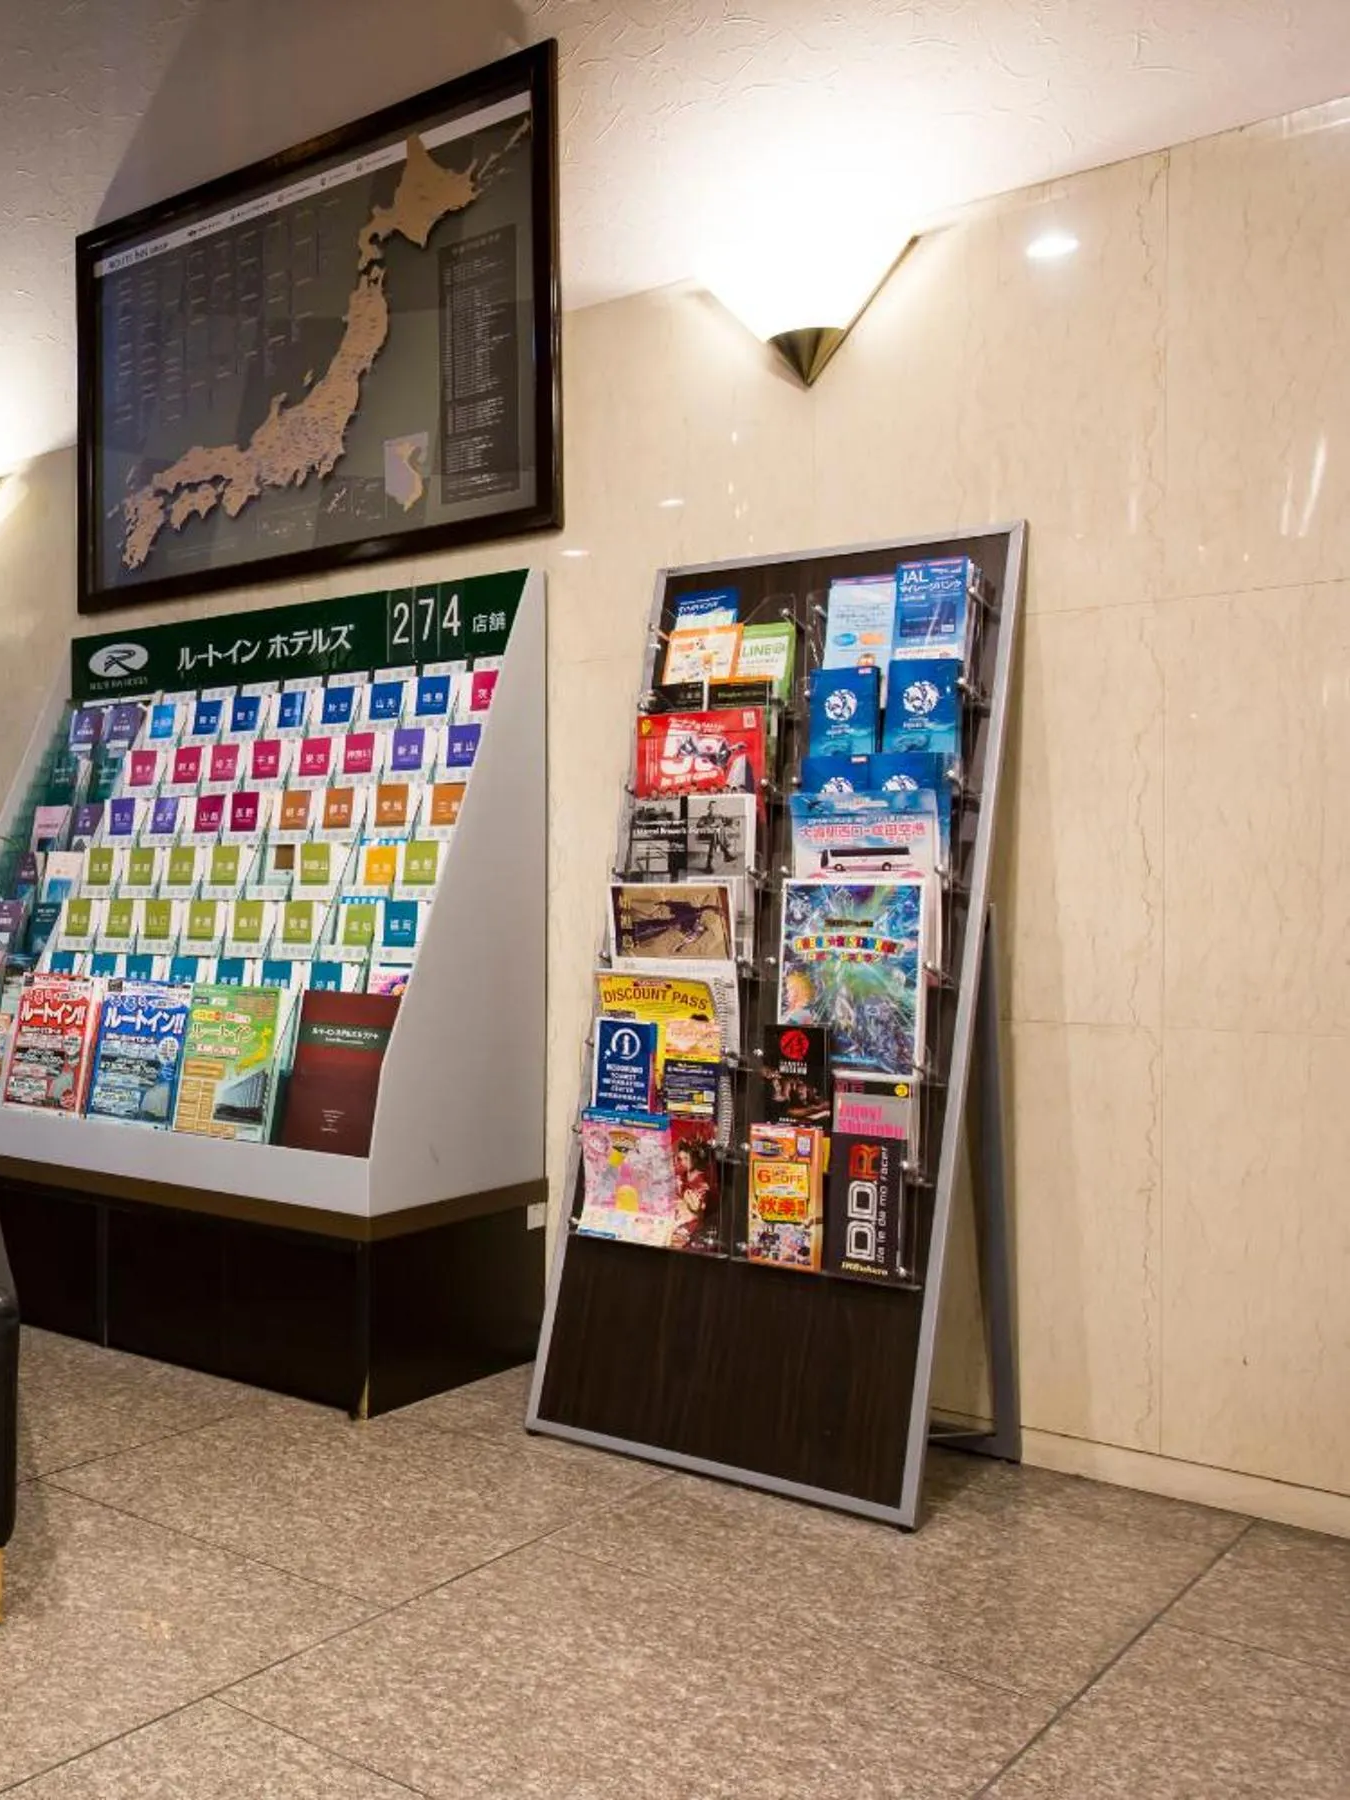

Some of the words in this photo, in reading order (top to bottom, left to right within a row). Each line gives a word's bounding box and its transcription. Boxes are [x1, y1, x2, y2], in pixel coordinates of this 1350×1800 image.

[901, 570, 929, 585] JAL
[177, 639, 262, 671] ルートイン
[267, 624, 355, 660] ホテルズ
[392, 593, 461, 645] 274
[472, 611, 507, 633] 店舗
[478, 688, 494, 699] 茨
[603, 987, 668, 1004] DISCOUNT
[672, 991, 708, 1010] PASS
[191, 1023, 256, 1043] ルートイン
